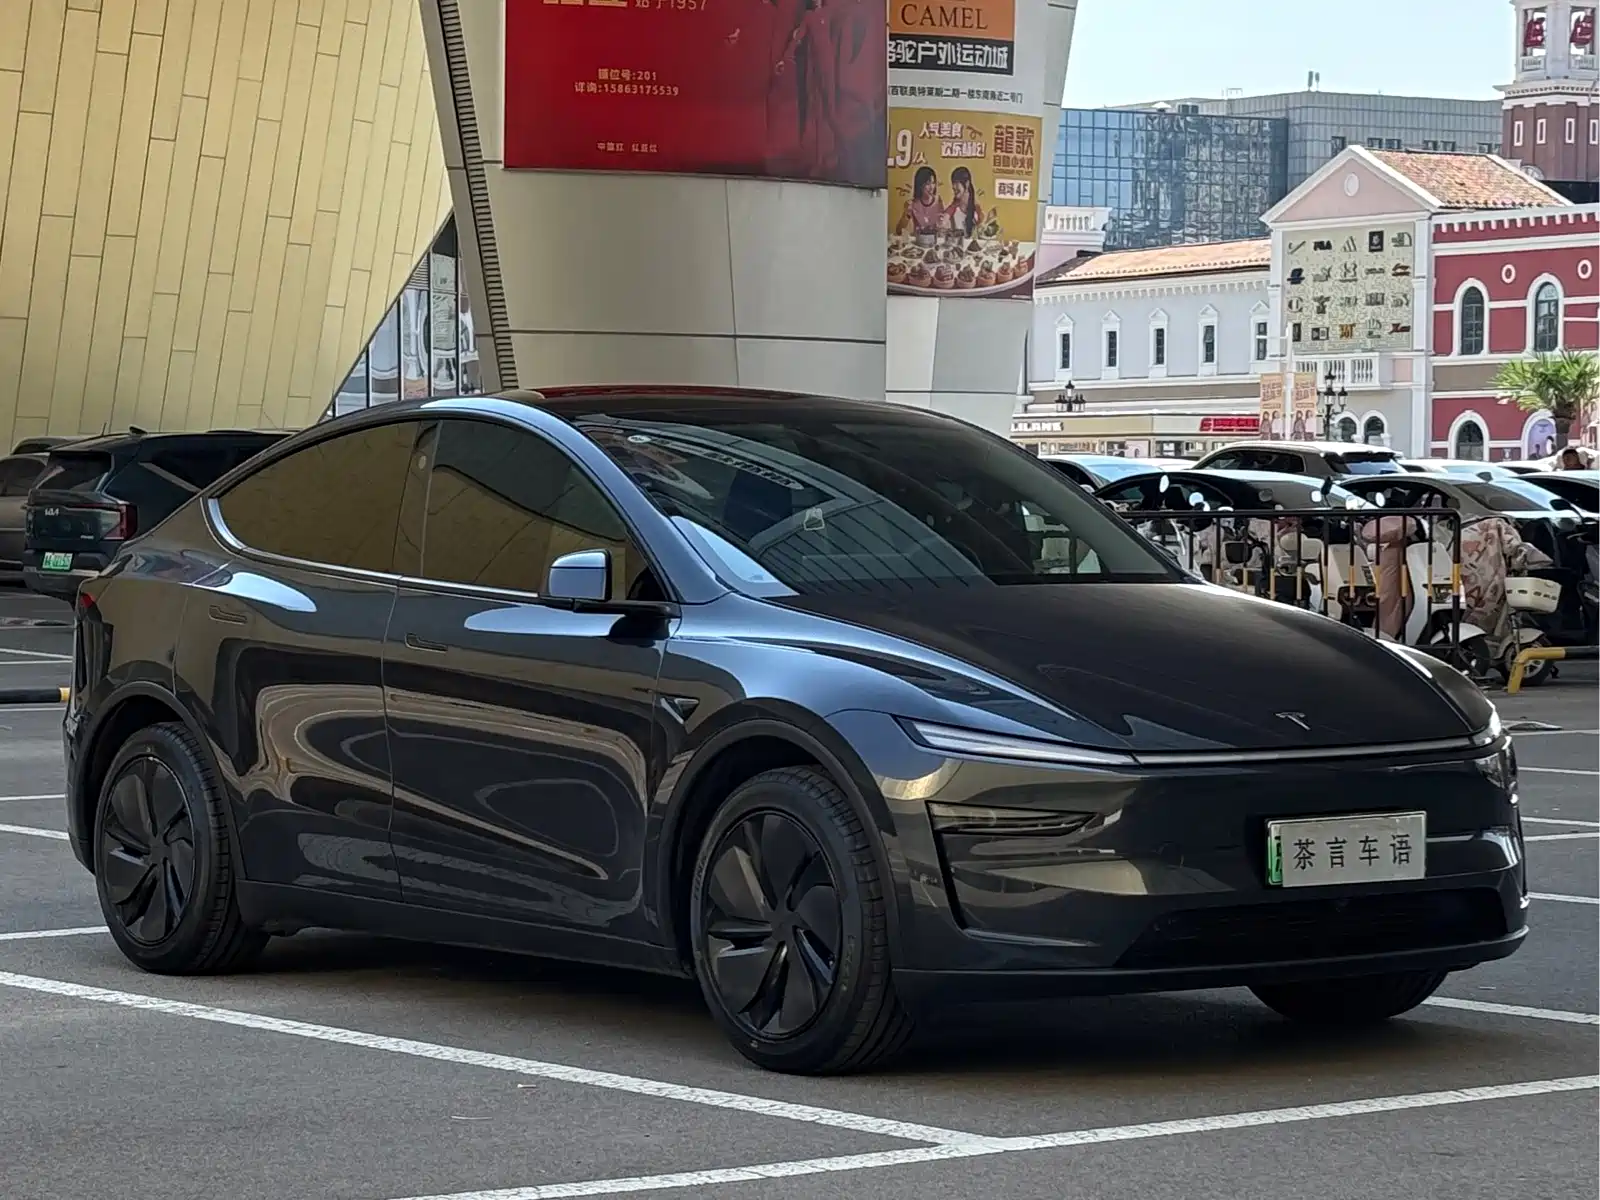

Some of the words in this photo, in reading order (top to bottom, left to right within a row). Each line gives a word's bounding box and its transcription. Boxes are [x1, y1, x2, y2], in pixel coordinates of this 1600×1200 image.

[901, 3, 988, 30] CAMEL
[919, 121, 963, 138] 人气美食
[994, 123, 1035, 156] 龍歌
[1292, 833, 1412, 870] 茶言车语
